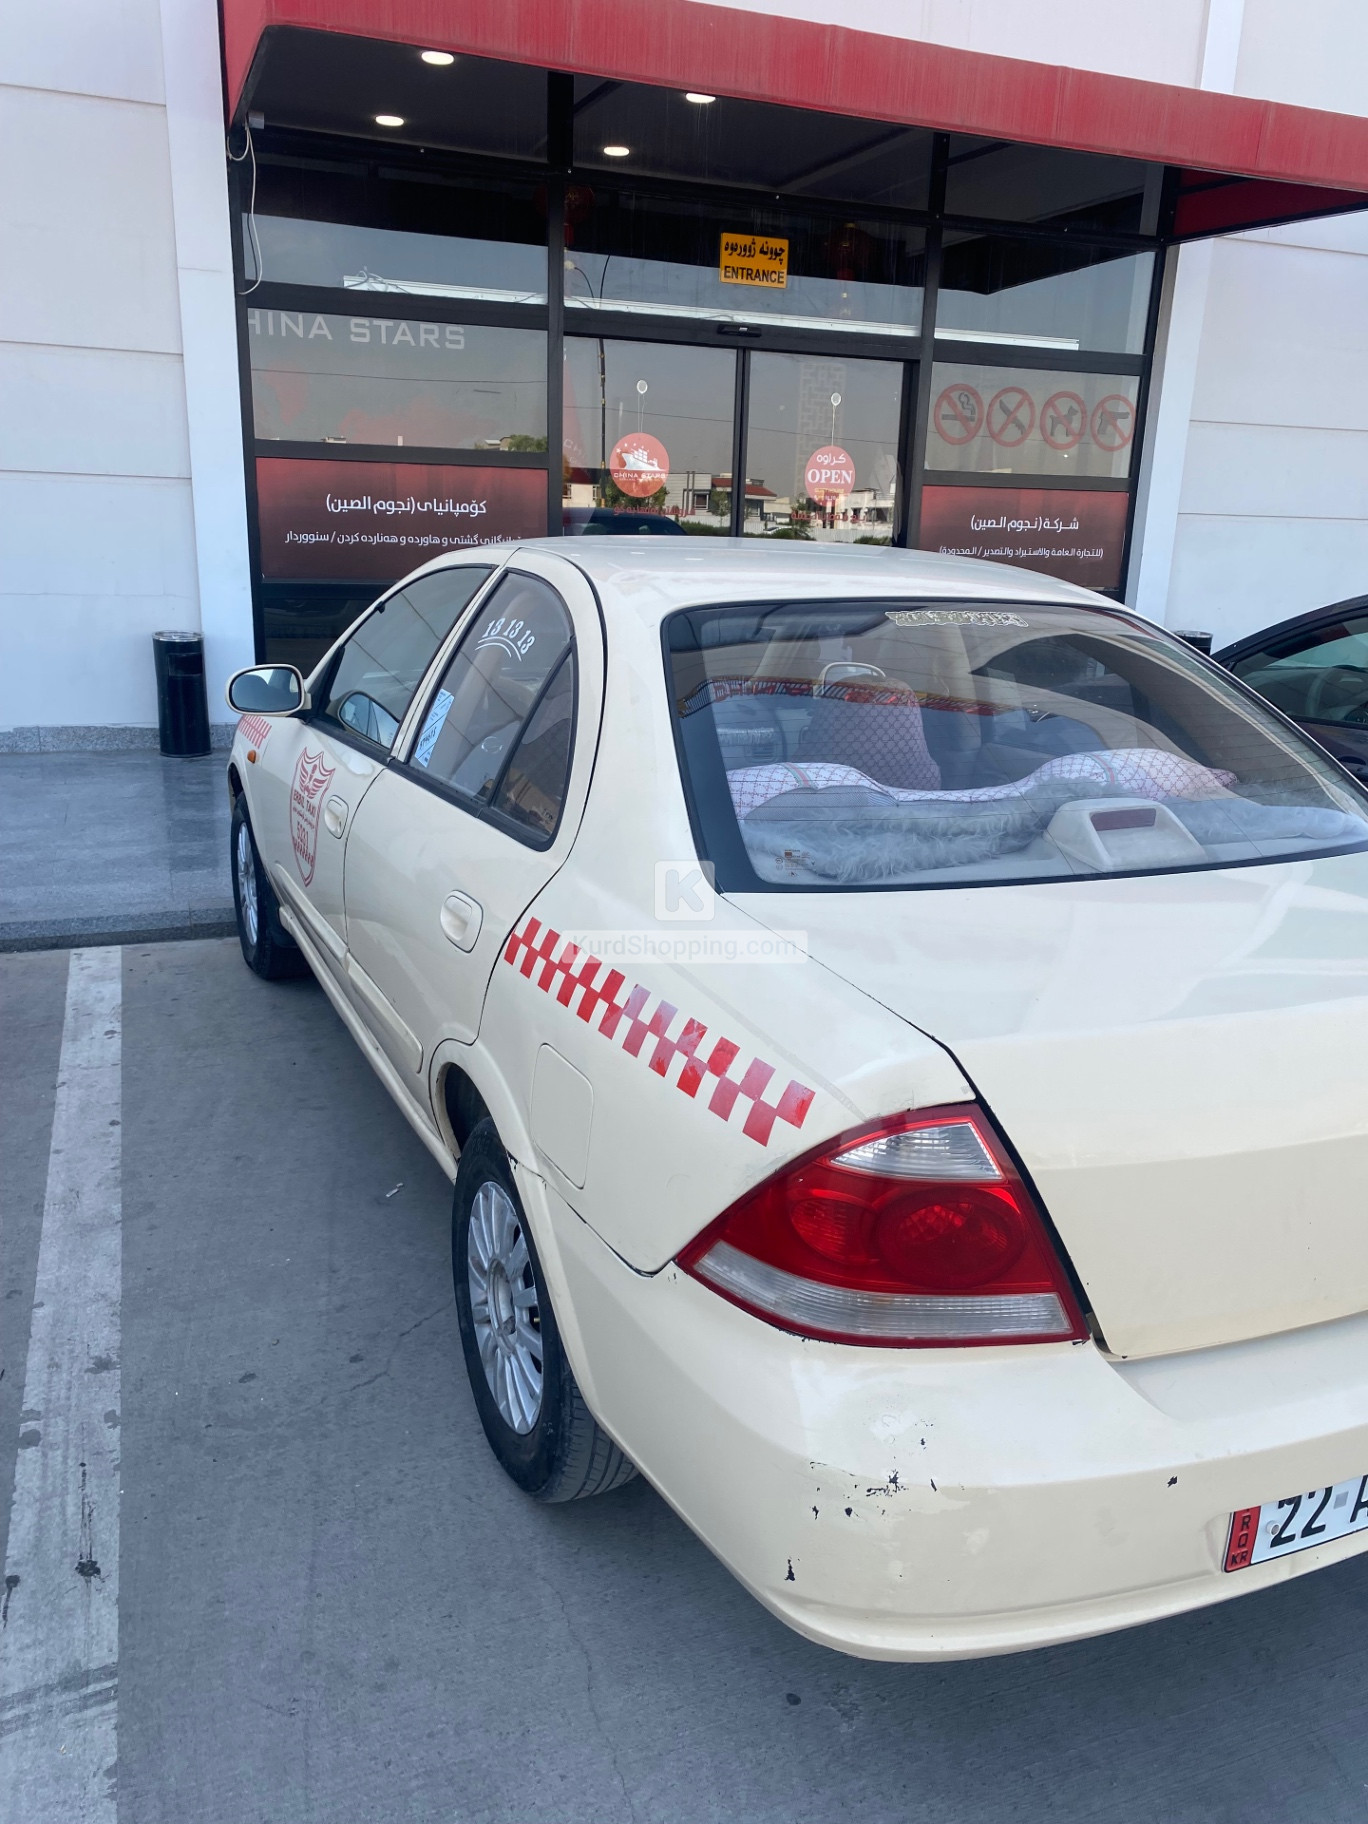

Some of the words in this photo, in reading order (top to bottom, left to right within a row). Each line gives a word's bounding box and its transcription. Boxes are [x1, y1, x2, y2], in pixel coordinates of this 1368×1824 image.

[724, 265, 784, 284] ENTRANCE
[350, 318, 465, 350] STARS
[807, 468, 853, 484] OPEN
[1043, 516, 1079, 533] شركة
[481, 617, 506, 638] 13
[503, 618, 524, 639] 13
[516, 629, 536, 655] 13
[1269, 1486, 1333, 1548] 22
